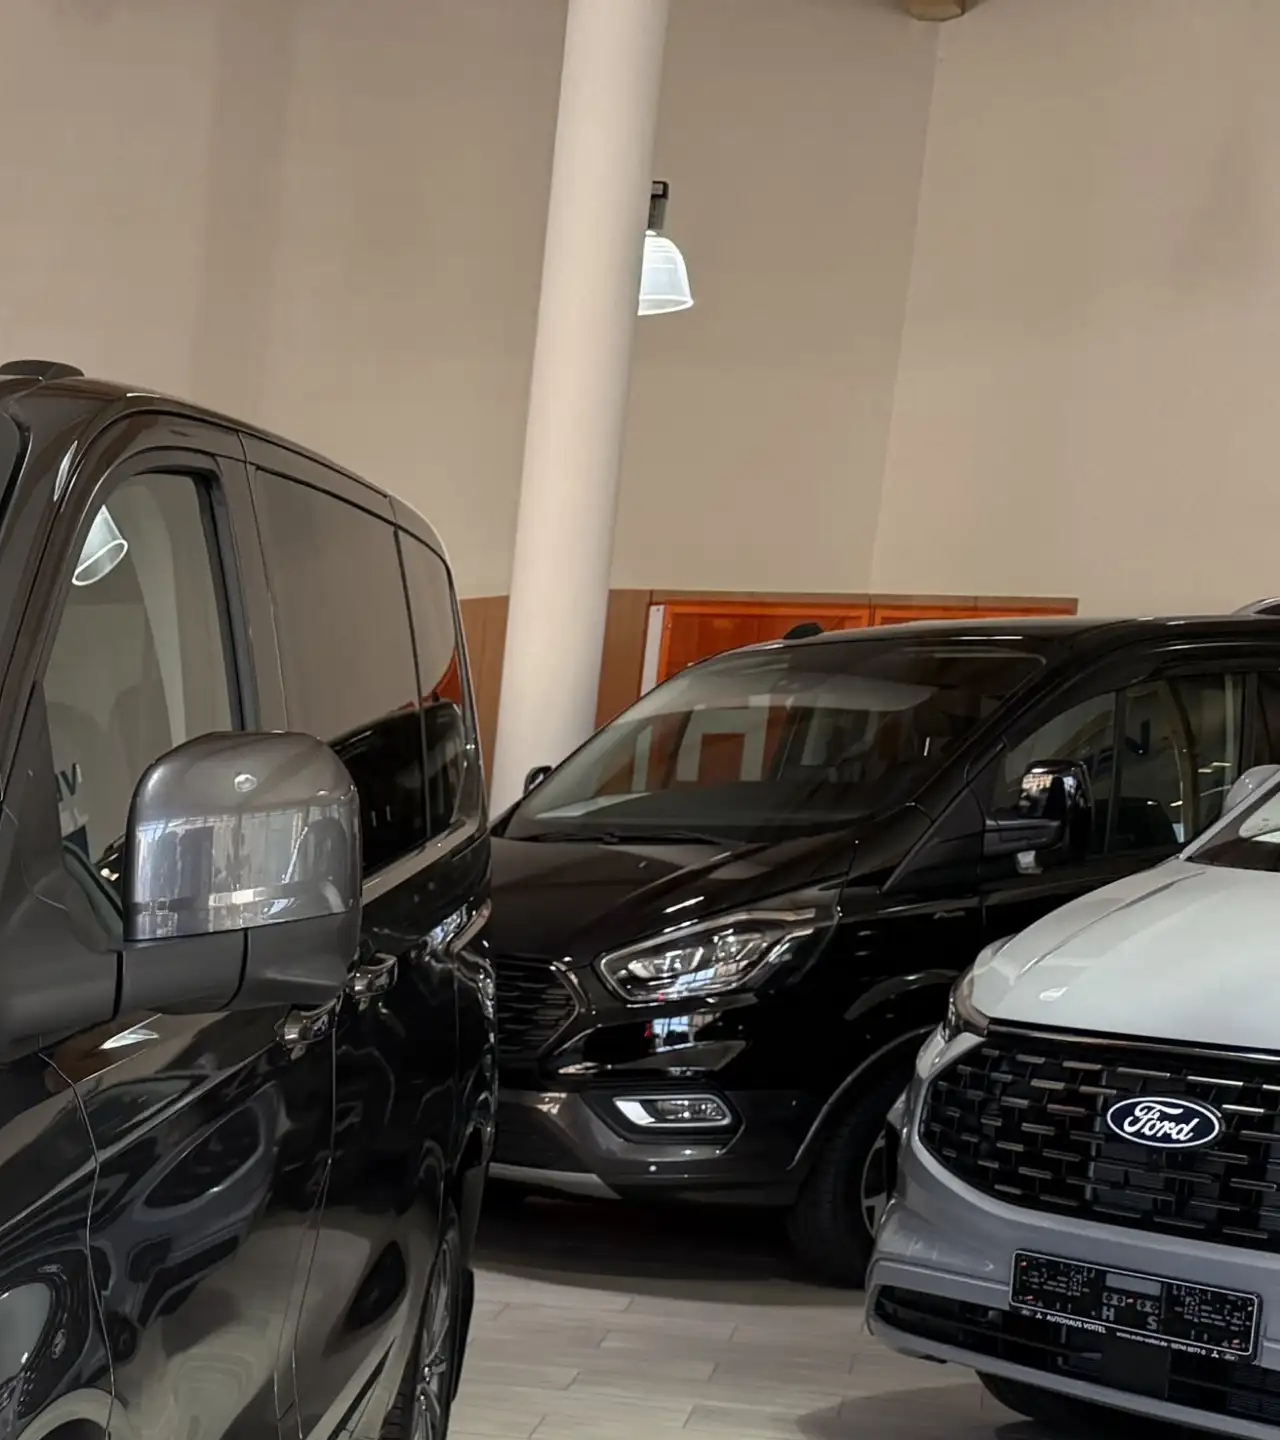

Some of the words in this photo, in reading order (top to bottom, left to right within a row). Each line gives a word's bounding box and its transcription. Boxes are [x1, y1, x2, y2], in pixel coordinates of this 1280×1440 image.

[1123, 1102, 1200, 1141] Ford
[1046, 1314, 1082, 1328] AUTOHAUS
[1083, 1322, 1106, 1334] VOITEL
